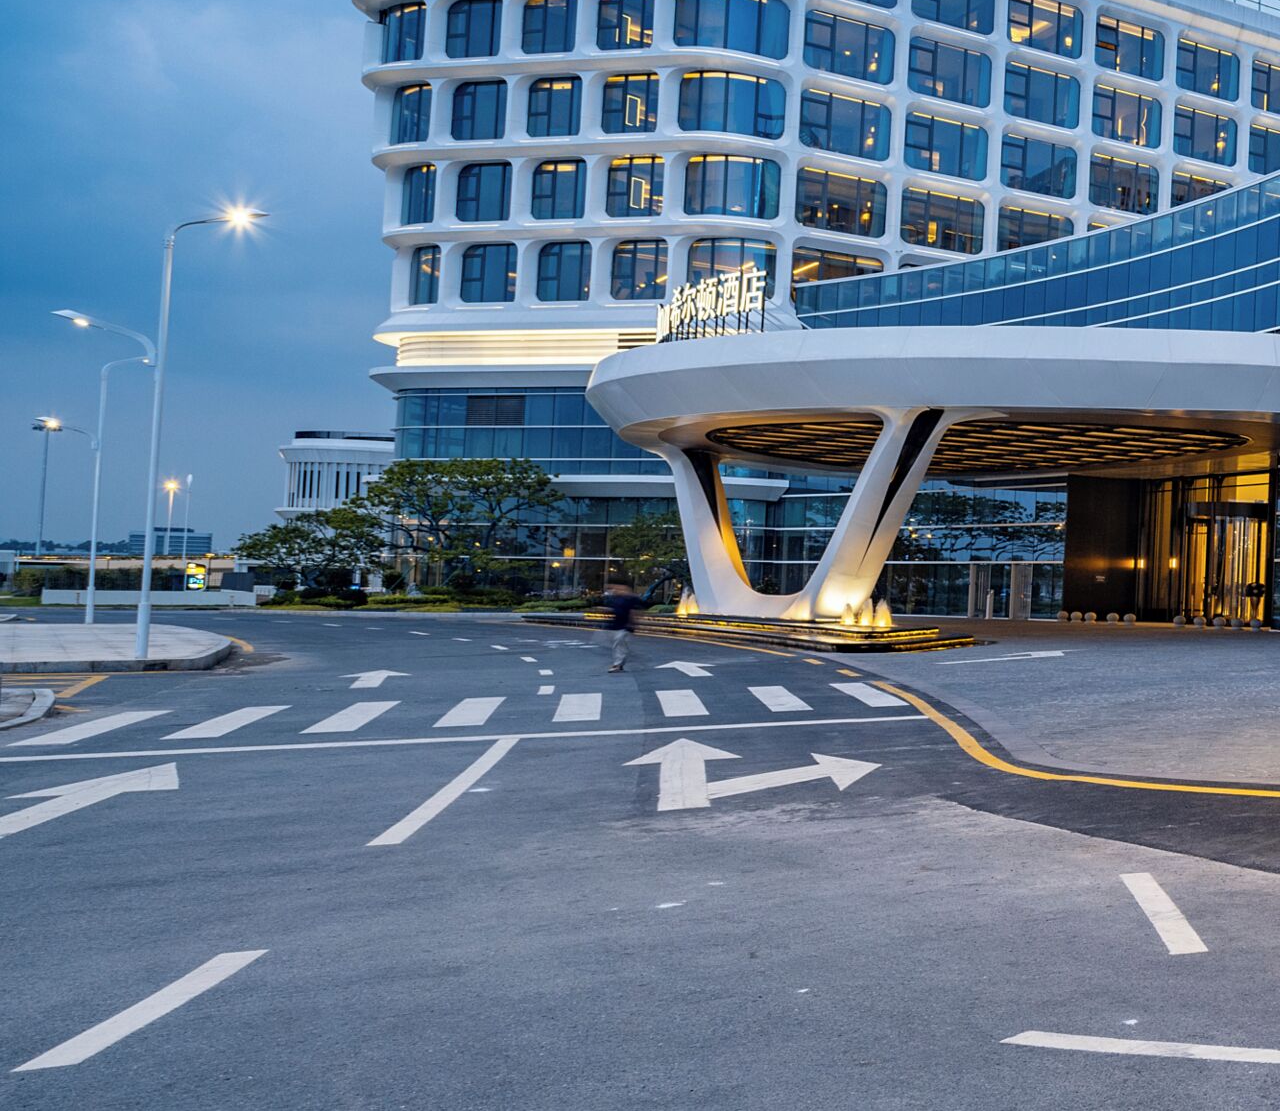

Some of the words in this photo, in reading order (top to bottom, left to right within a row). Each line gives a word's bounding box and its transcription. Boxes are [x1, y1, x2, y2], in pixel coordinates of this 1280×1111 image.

[670, 267, 768, 329] 希尔顿酒店
